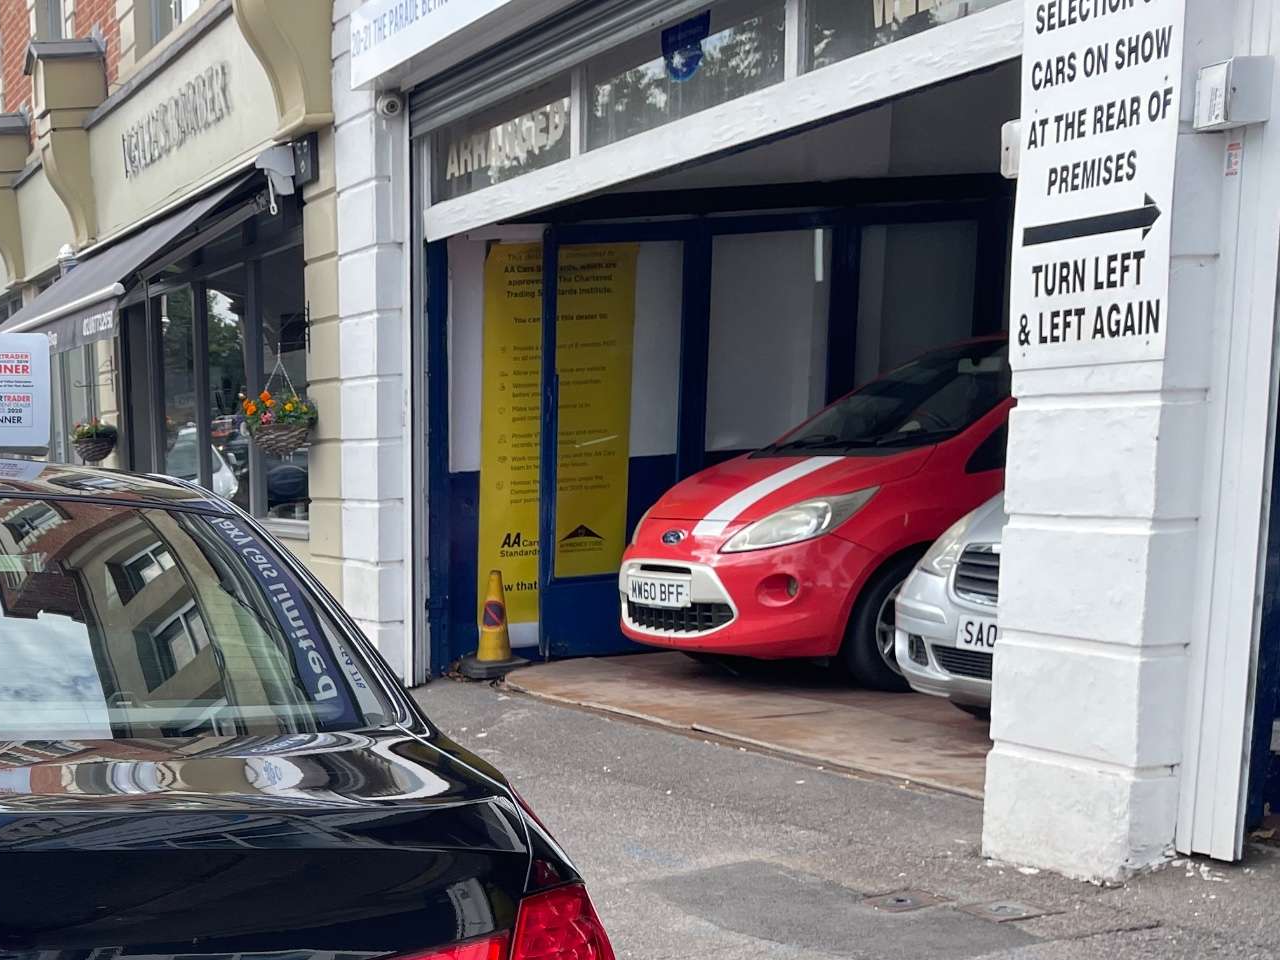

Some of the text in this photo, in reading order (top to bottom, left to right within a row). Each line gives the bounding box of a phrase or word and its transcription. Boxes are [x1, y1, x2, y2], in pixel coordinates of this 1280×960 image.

[373, 13, 387, 45] THE
[389, 0, 419, 36] PARADE
[1036, 0, 1134, 35] SELECTI
[1032, 25, 1173, 91] CARS ON SHOW
[1027, 116, 1049, 150] AT
[1054, 108, 1086, 144] THE
[1093, 95, 1141, 135] REAR
[1148, 86, 1173, 123] OF
[1047, 149, 1137, 196] PREMISES
[1032, 250, 1146, 298] TURN LEFT
[1018, 299, 1160, 346] & LEFT AGAIN
[501, 533, 521, 548] AA
[516, 581, 538, 592] that
[631, 579, 685, 603] MW60 BFF
